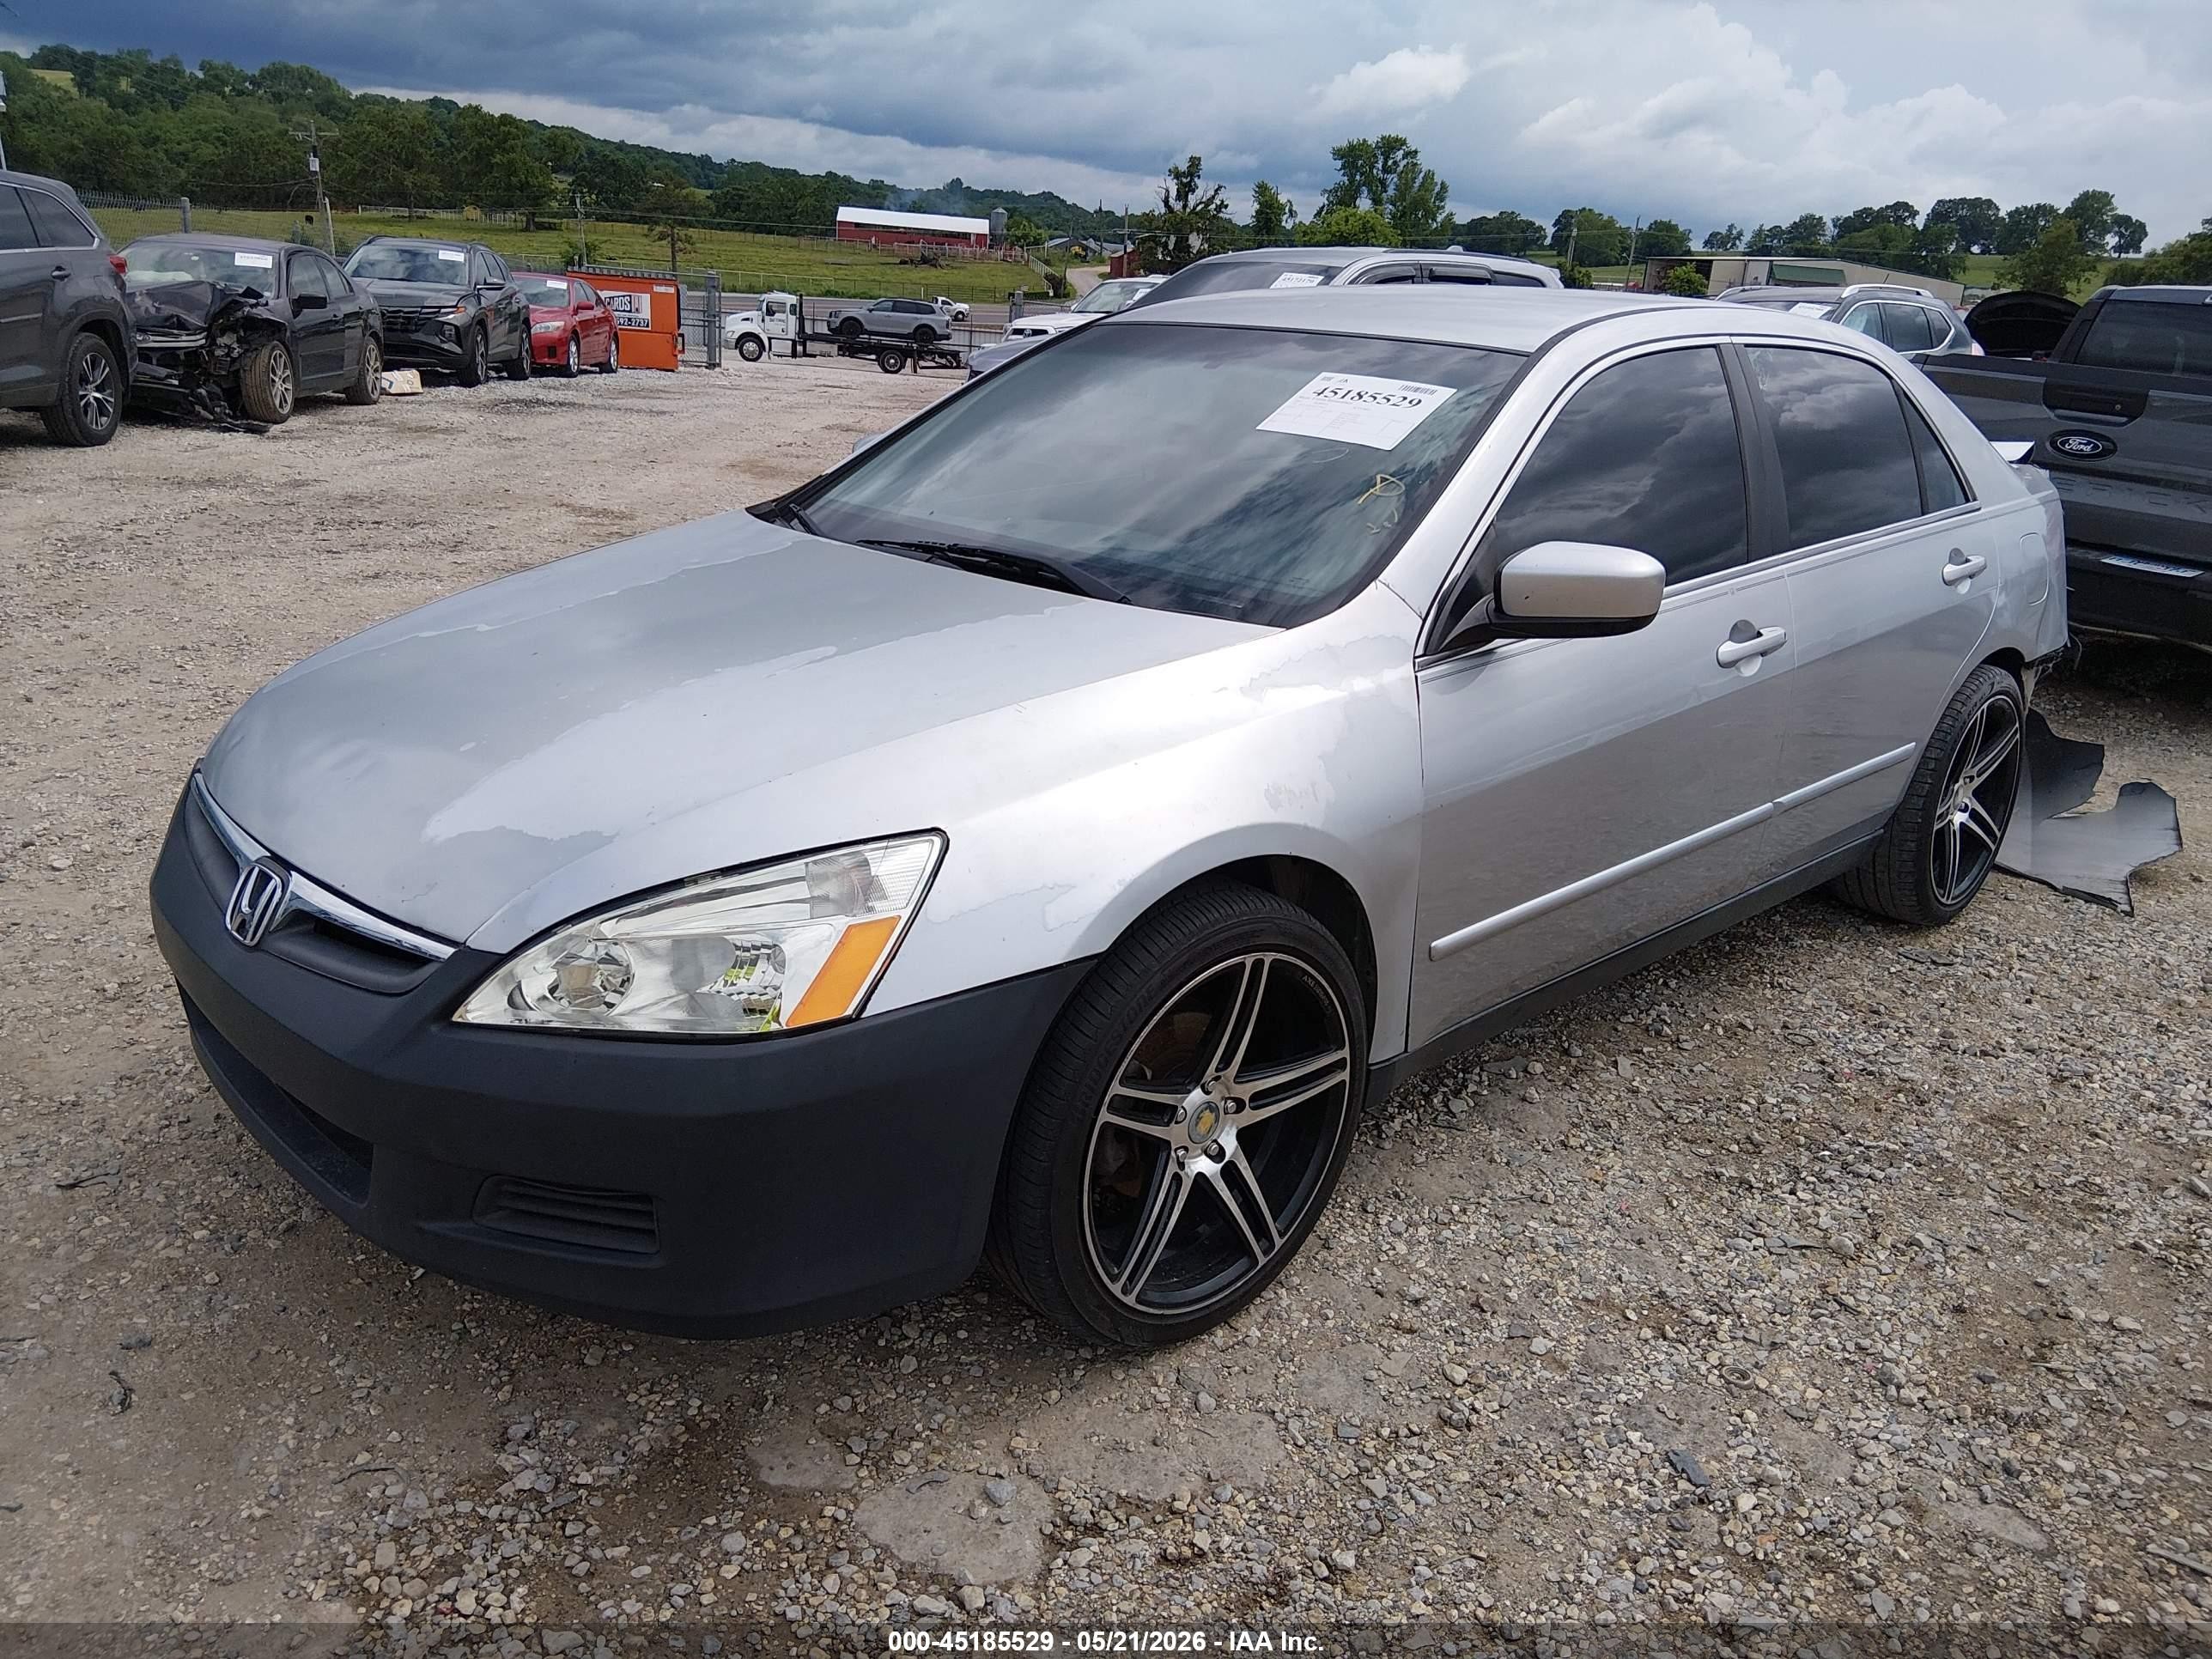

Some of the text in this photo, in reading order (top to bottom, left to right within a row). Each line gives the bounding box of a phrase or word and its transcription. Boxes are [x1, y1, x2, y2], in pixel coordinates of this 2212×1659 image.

[605, 296, 630, 311] CARDS
[1312, 386, 1423, 409] 45185529
[2064, 438, 2094, 453] Ford
